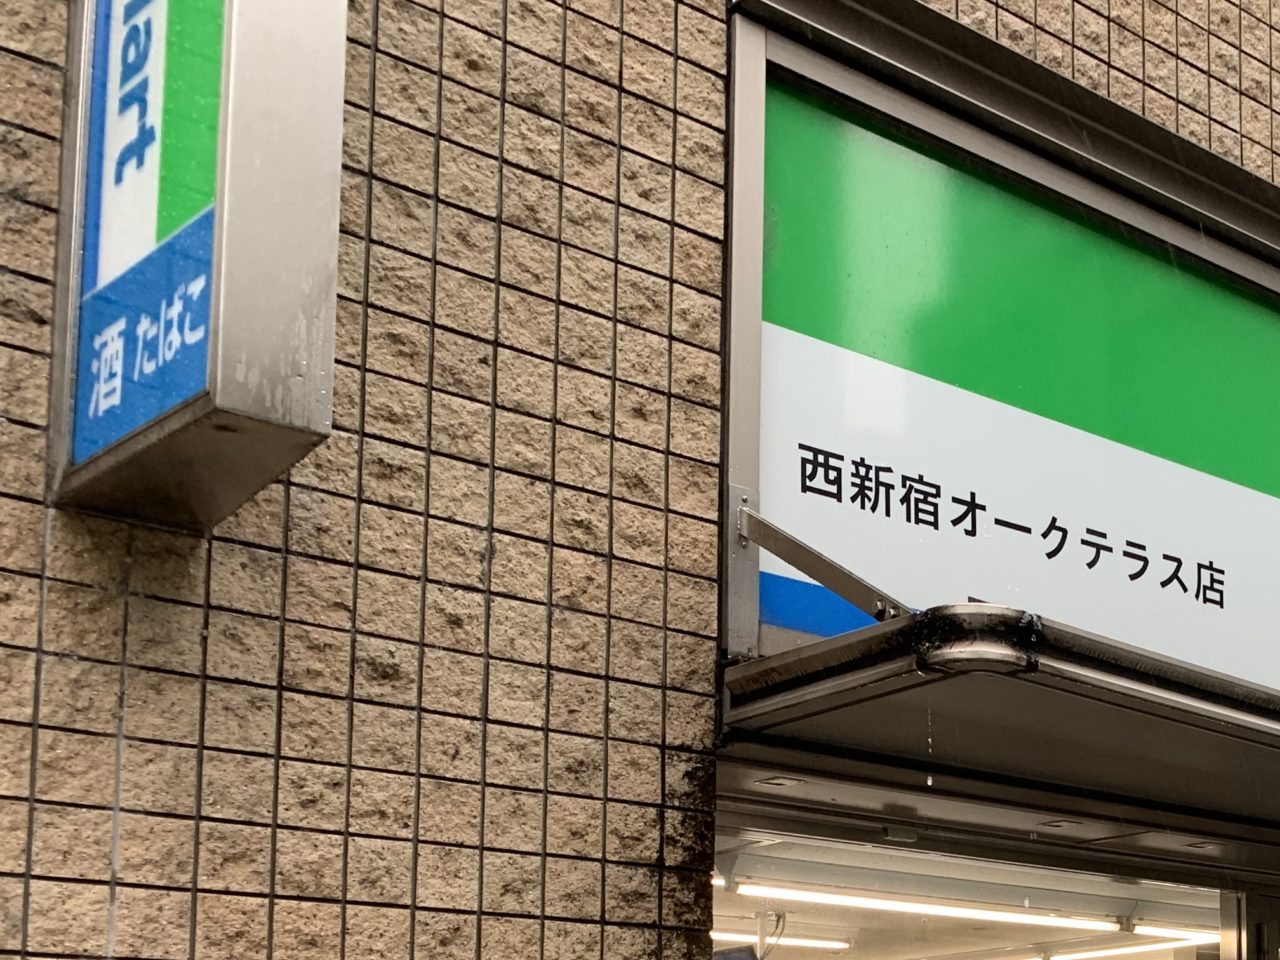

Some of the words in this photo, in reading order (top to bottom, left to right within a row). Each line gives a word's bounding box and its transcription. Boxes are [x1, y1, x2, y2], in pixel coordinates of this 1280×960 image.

[88, 316, 127, 419] 酒
[133, 274, 206, 382] たばこ
[798, 443, 1225, 609] 西新宿オークテラス店
